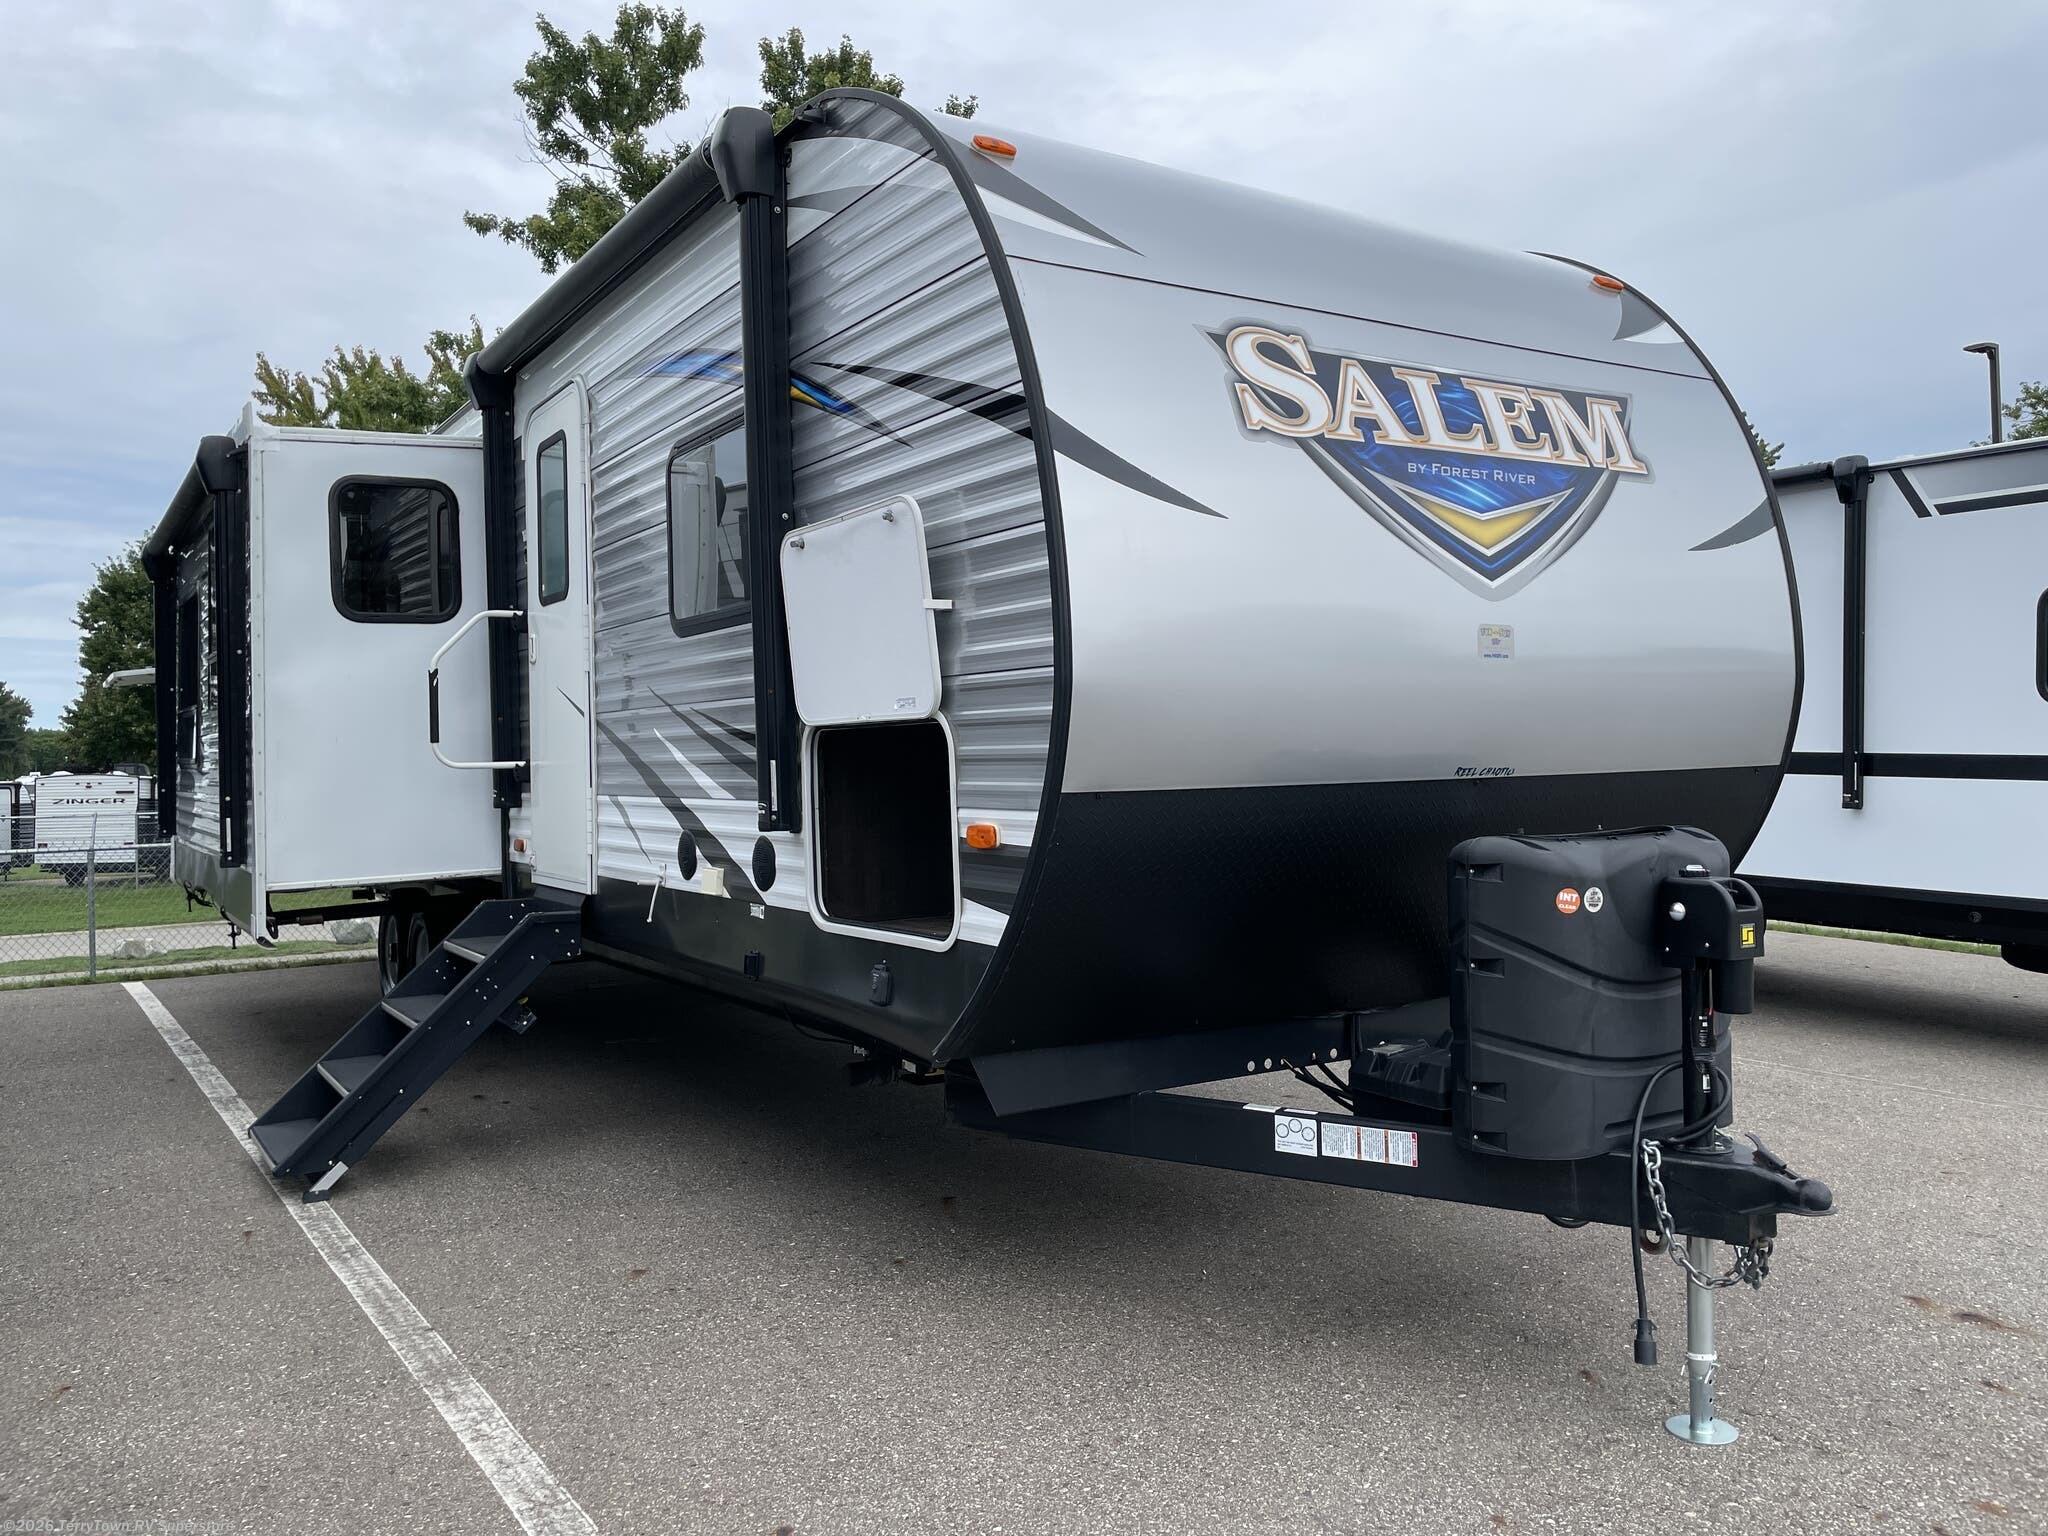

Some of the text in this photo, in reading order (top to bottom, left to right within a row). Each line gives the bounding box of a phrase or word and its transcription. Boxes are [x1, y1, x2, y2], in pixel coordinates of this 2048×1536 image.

[1225, 325, 1648, 475] SALEM
[1431, 463, 1489, 480] FOREST
[1493, 470, 1536, 485] RIVER
[1559, 891, 1579, 902] INT
